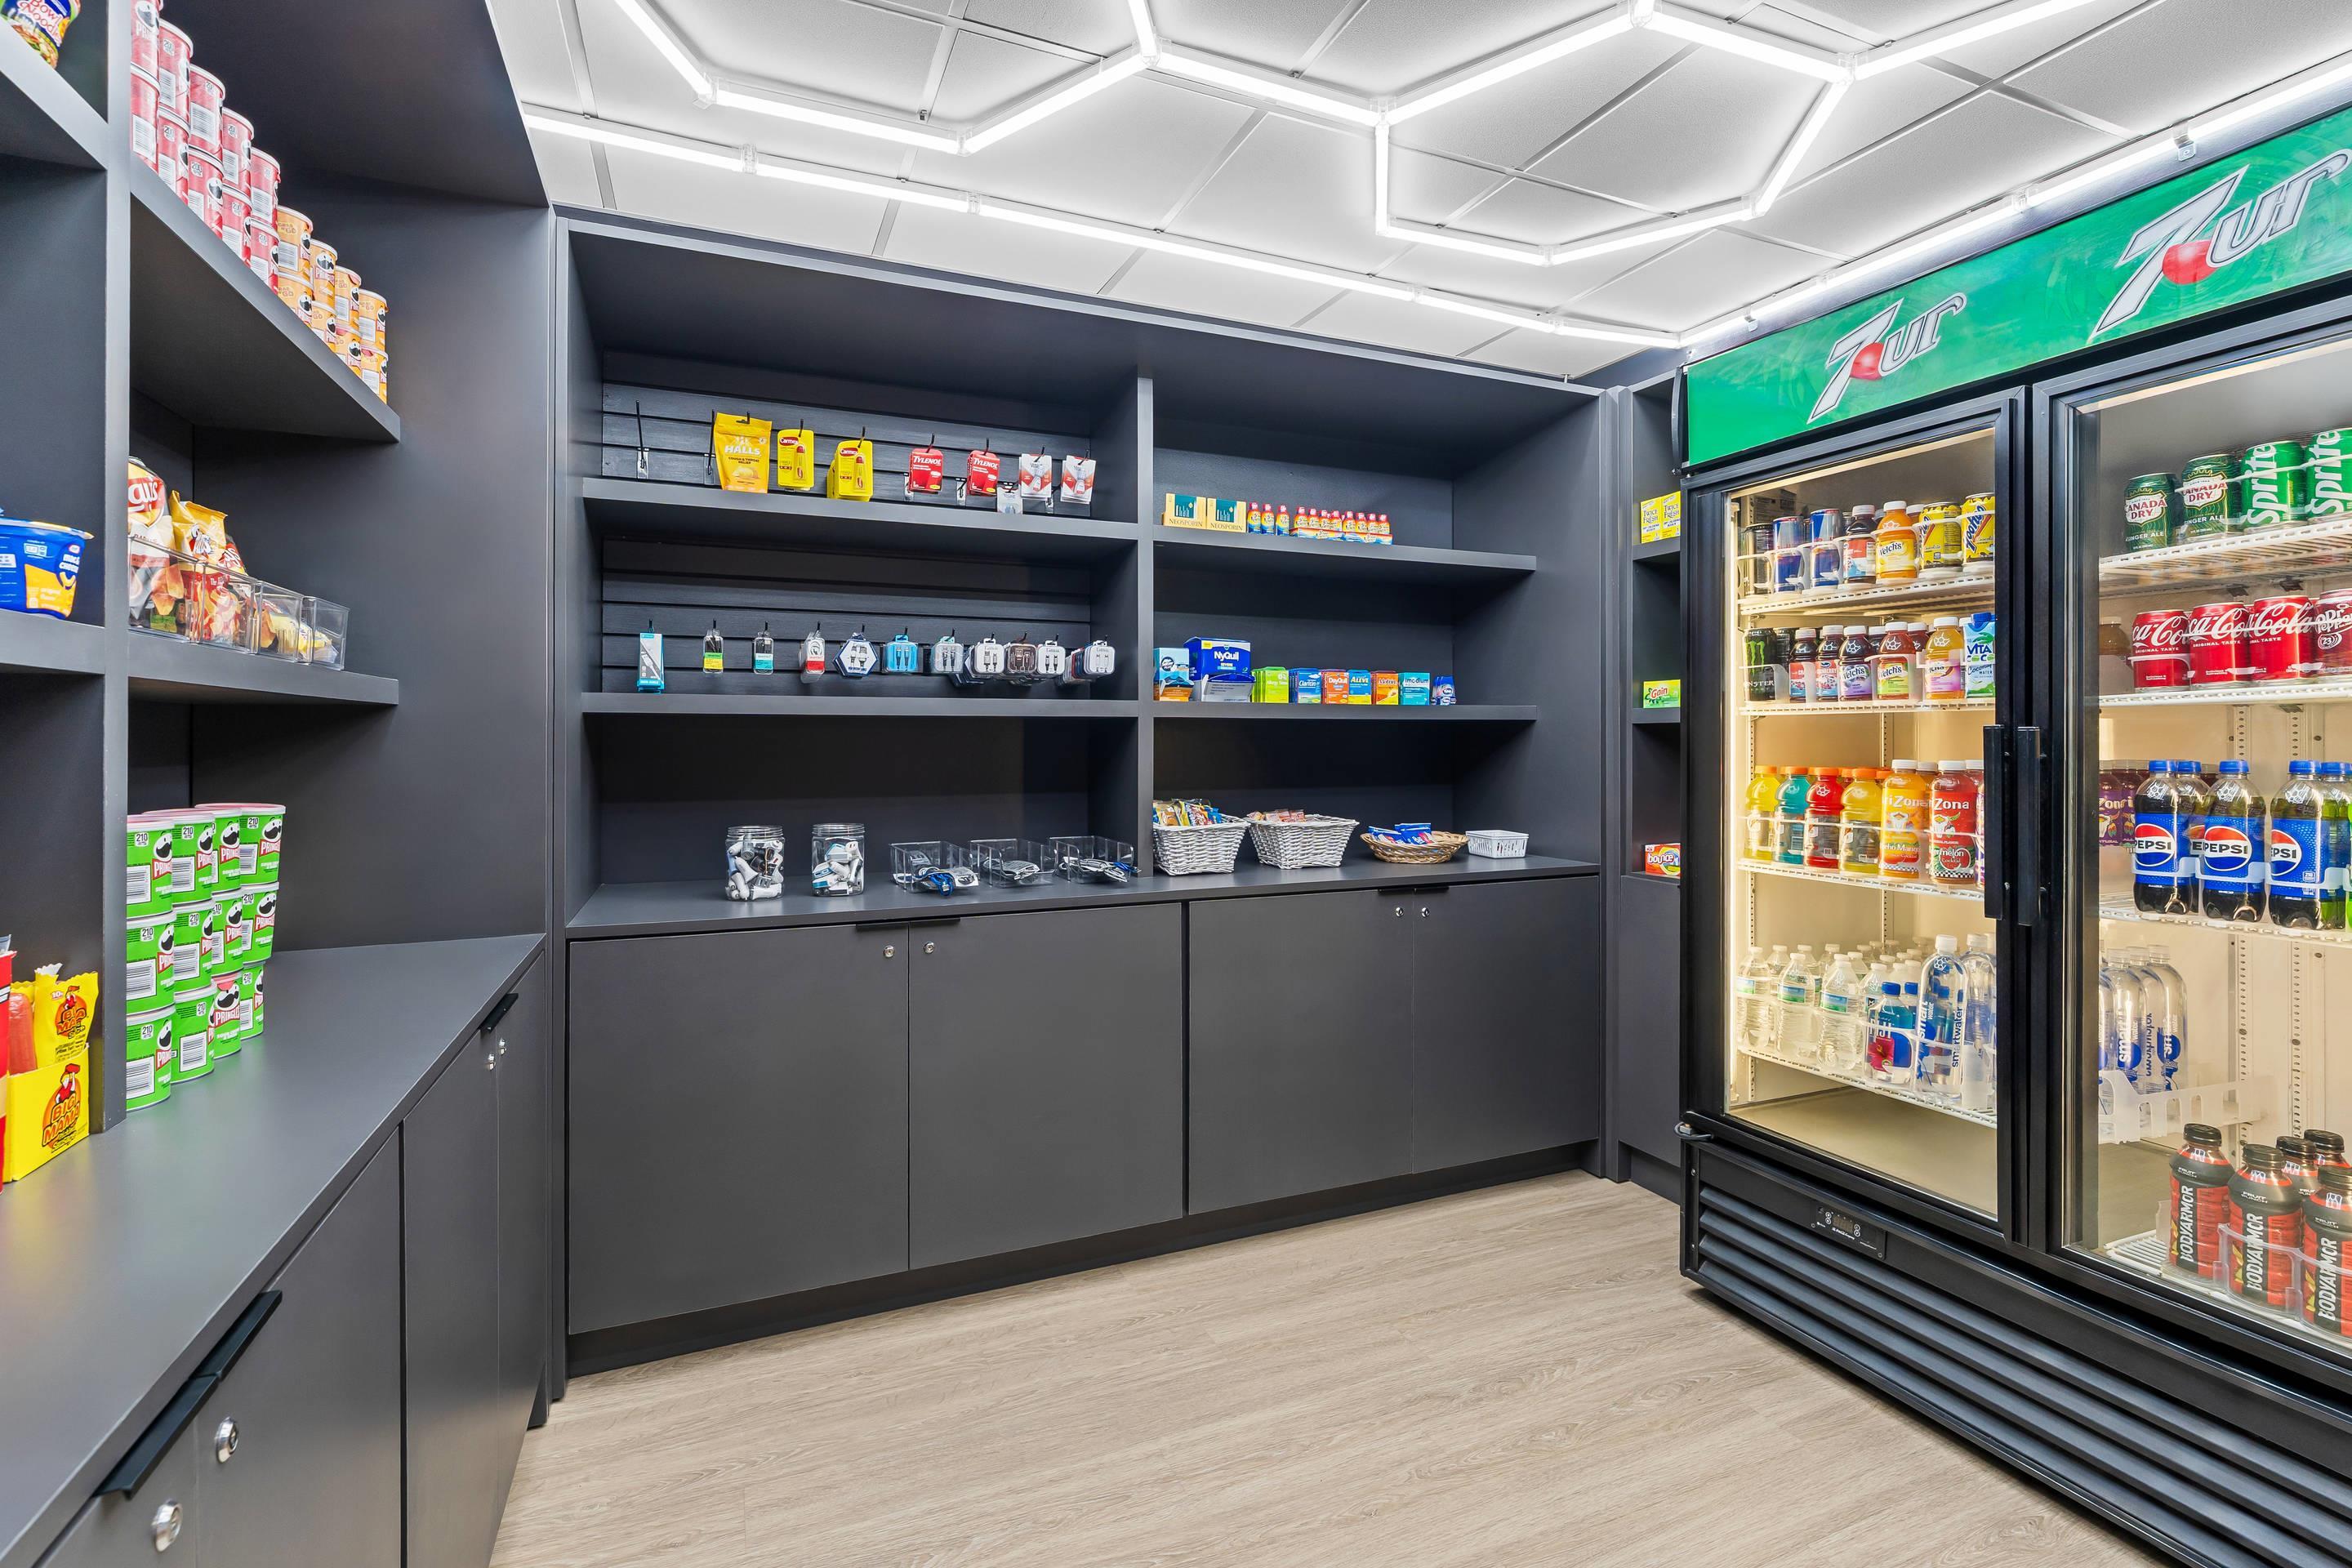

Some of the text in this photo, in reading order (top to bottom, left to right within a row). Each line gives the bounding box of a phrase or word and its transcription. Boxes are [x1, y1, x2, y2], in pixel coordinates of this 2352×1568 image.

[724, 444, 761, 456] HALLS
[913, 456, 941, 466] TYLENOL
[973, 458, 999, 469] TYLENOL
[2245, 444, 2288, 524] Sprite
[2189, 492, 2212, 502] DRY
[2132, 508, 2154, 519] DRY
[1169, 519, 1203, 528] NEOSPORIN
[1210, 523, 1243, 531] NEOSPORIN
[2323, 637, 2332, 645] 23
[1967, 644, 1993, 654] VITA
[1214, 651, 1240, 662] NyQuil
[1328, 677, 1348, 685] DayQuil
[1650, 687, 1668, 699] Gain
[248, 817, 259, 826] 210
[183, 826, 194, 835] 210
[136, 833, 148, 842] 210
[2204, 843, 2248, 855] PEPSI
[1648, 853, 1674, 865] bounce
[243, 893, 254, 902] 210
[189, 914, 199, 923] 210
[142, 928, 154, 938] 210
[142, 1025, 153, 1036] 210
[51, 1093, 76, 1123] BIG
[42, 1102, 80, 1147] MAMA
[2179, 1184, 2194, 1263] BODYARMOR
[2246, 1212, 2264, 1291] BODYARMOR
[2318, 1236, 2338, 1321] BODYARMOR
